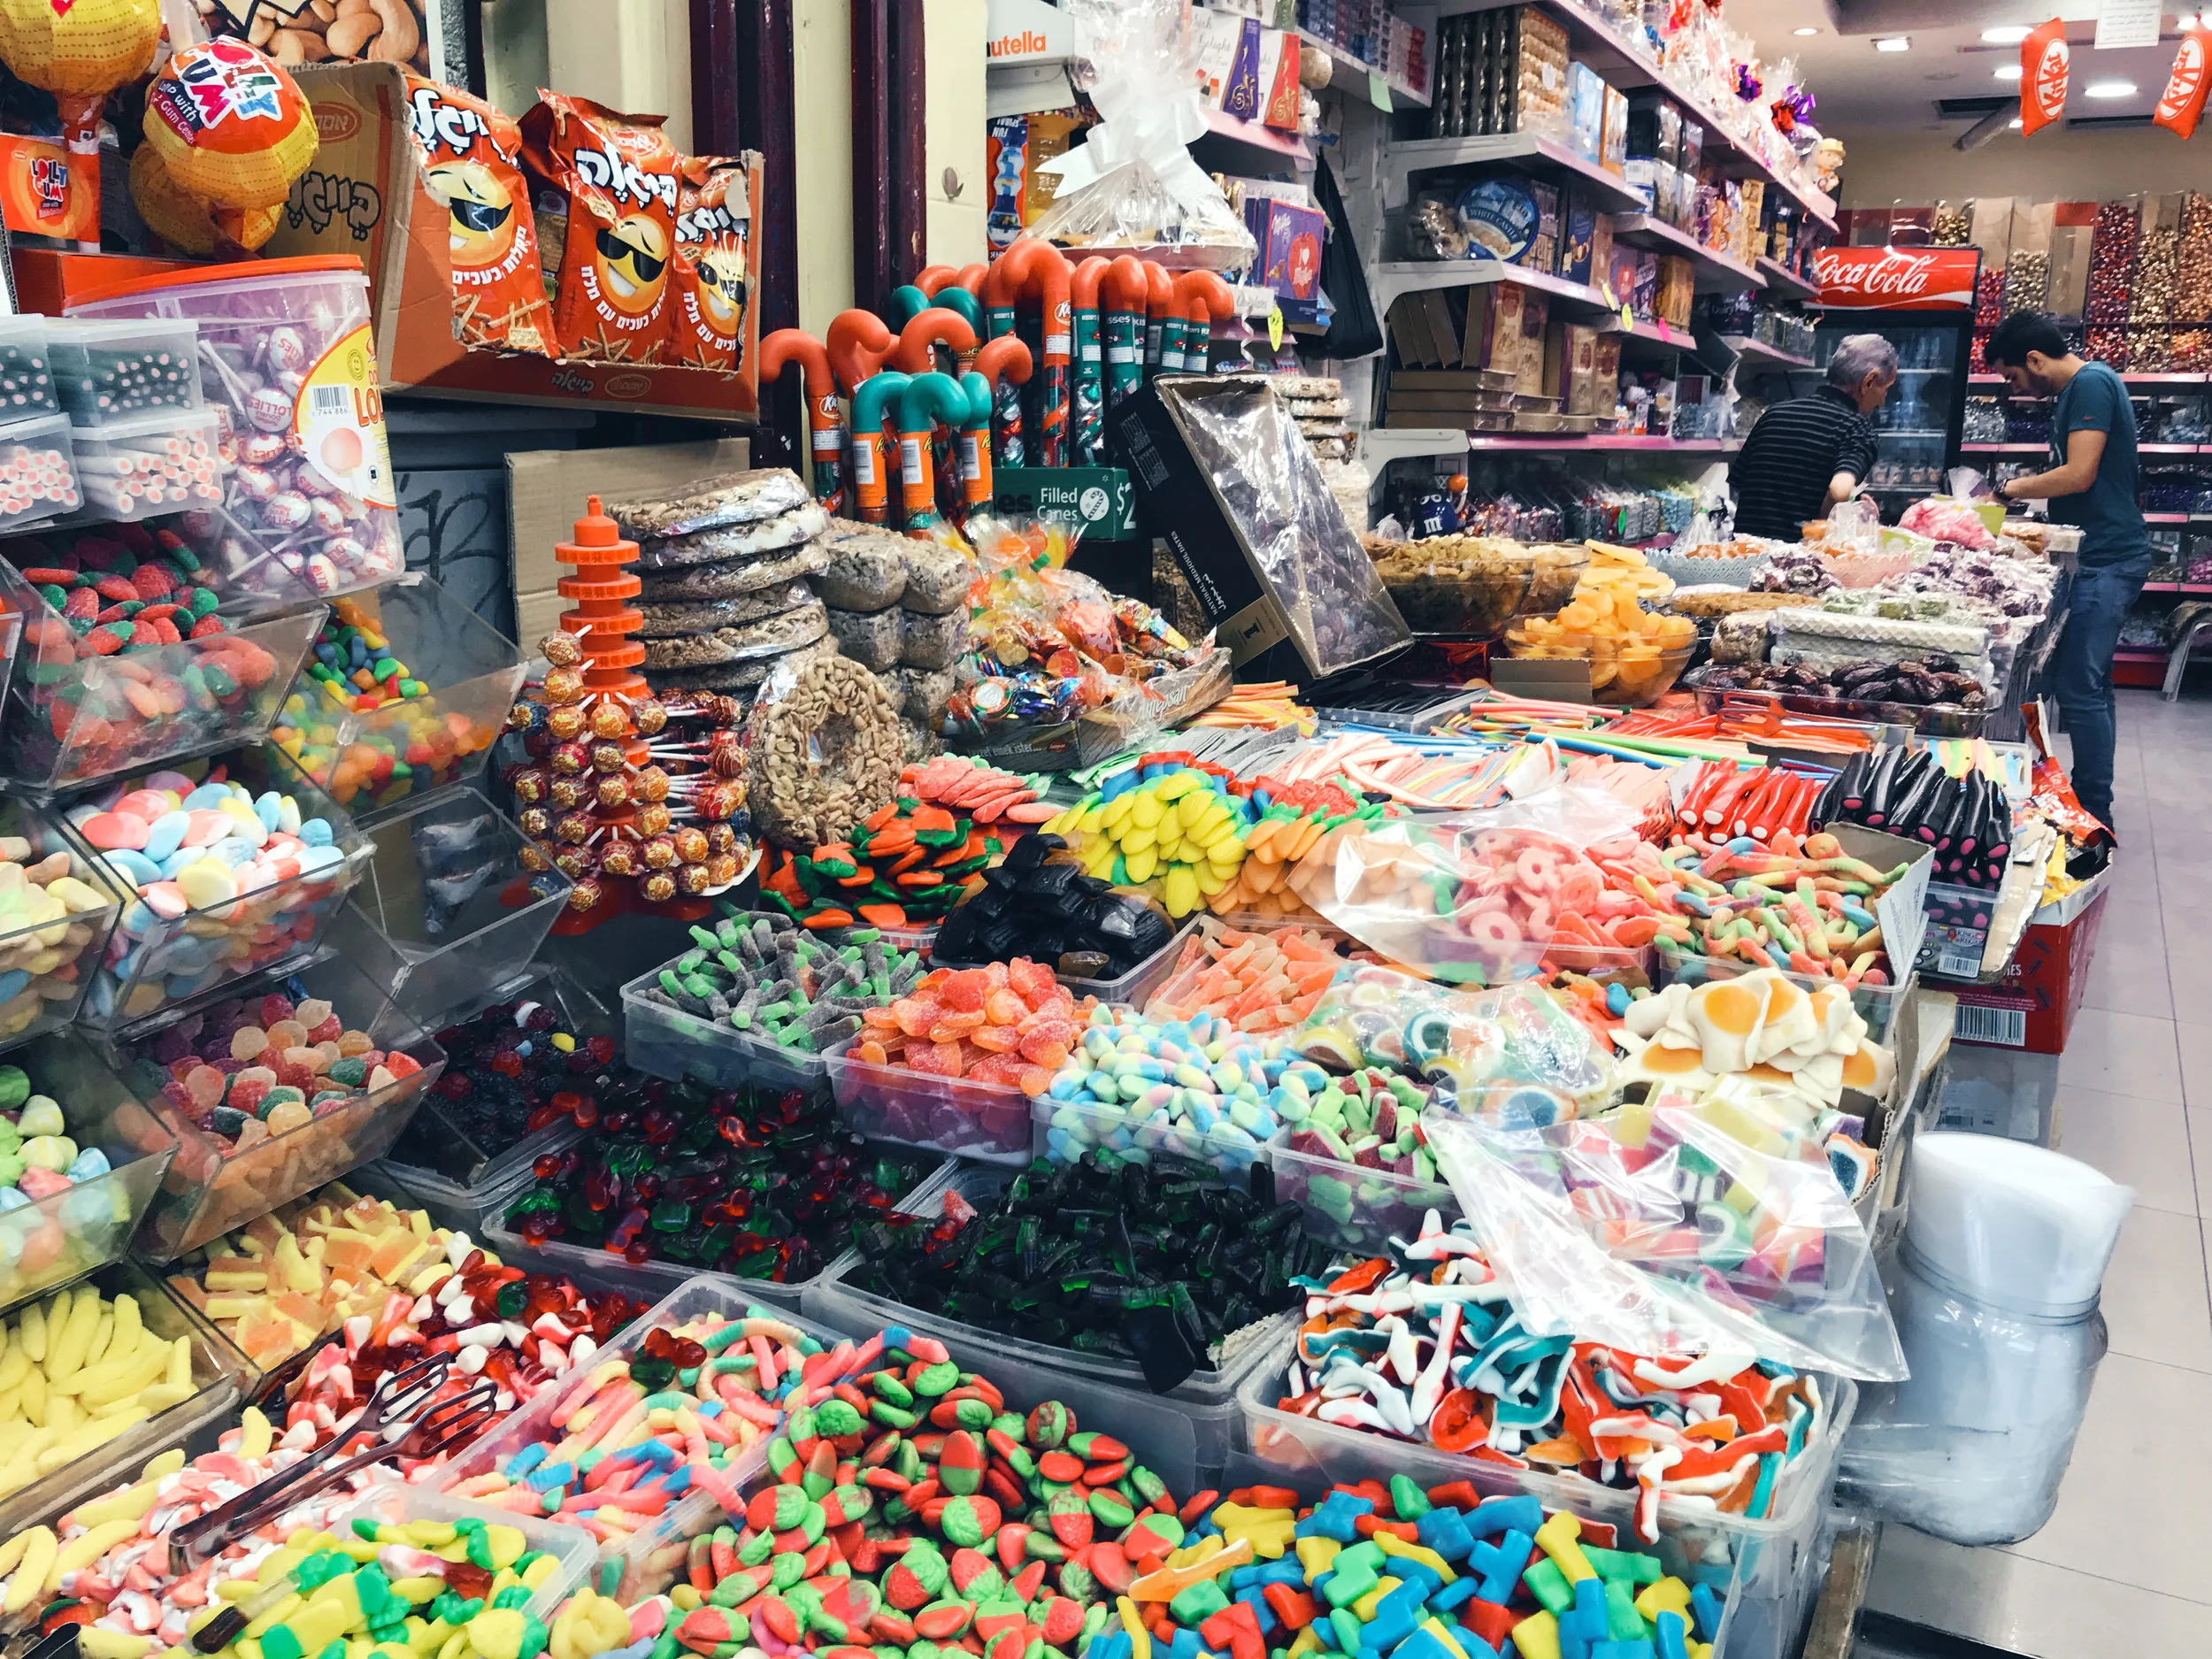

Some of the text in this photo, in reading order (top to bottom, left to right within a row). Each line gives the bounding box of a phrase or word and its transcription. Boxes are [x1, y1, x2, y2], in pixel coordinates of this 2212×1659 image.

[160, 100, 178, 124] Gum
[174, 95, 196, 122] with
[451, 266, 503, 286] כעכים
[580, 265, 601, 301] מלח
[1816, 252, 1939, 294] Coca-Cola
[595, 300, 617, 321] עם
[682, 291, 702, 325] מלח
[695, 323, 715, 342] עם
[996, 493, 1033, 514] es
[1041, 488, 1078, 503] Filled
[1037, 505, 1078, 522] Canes
